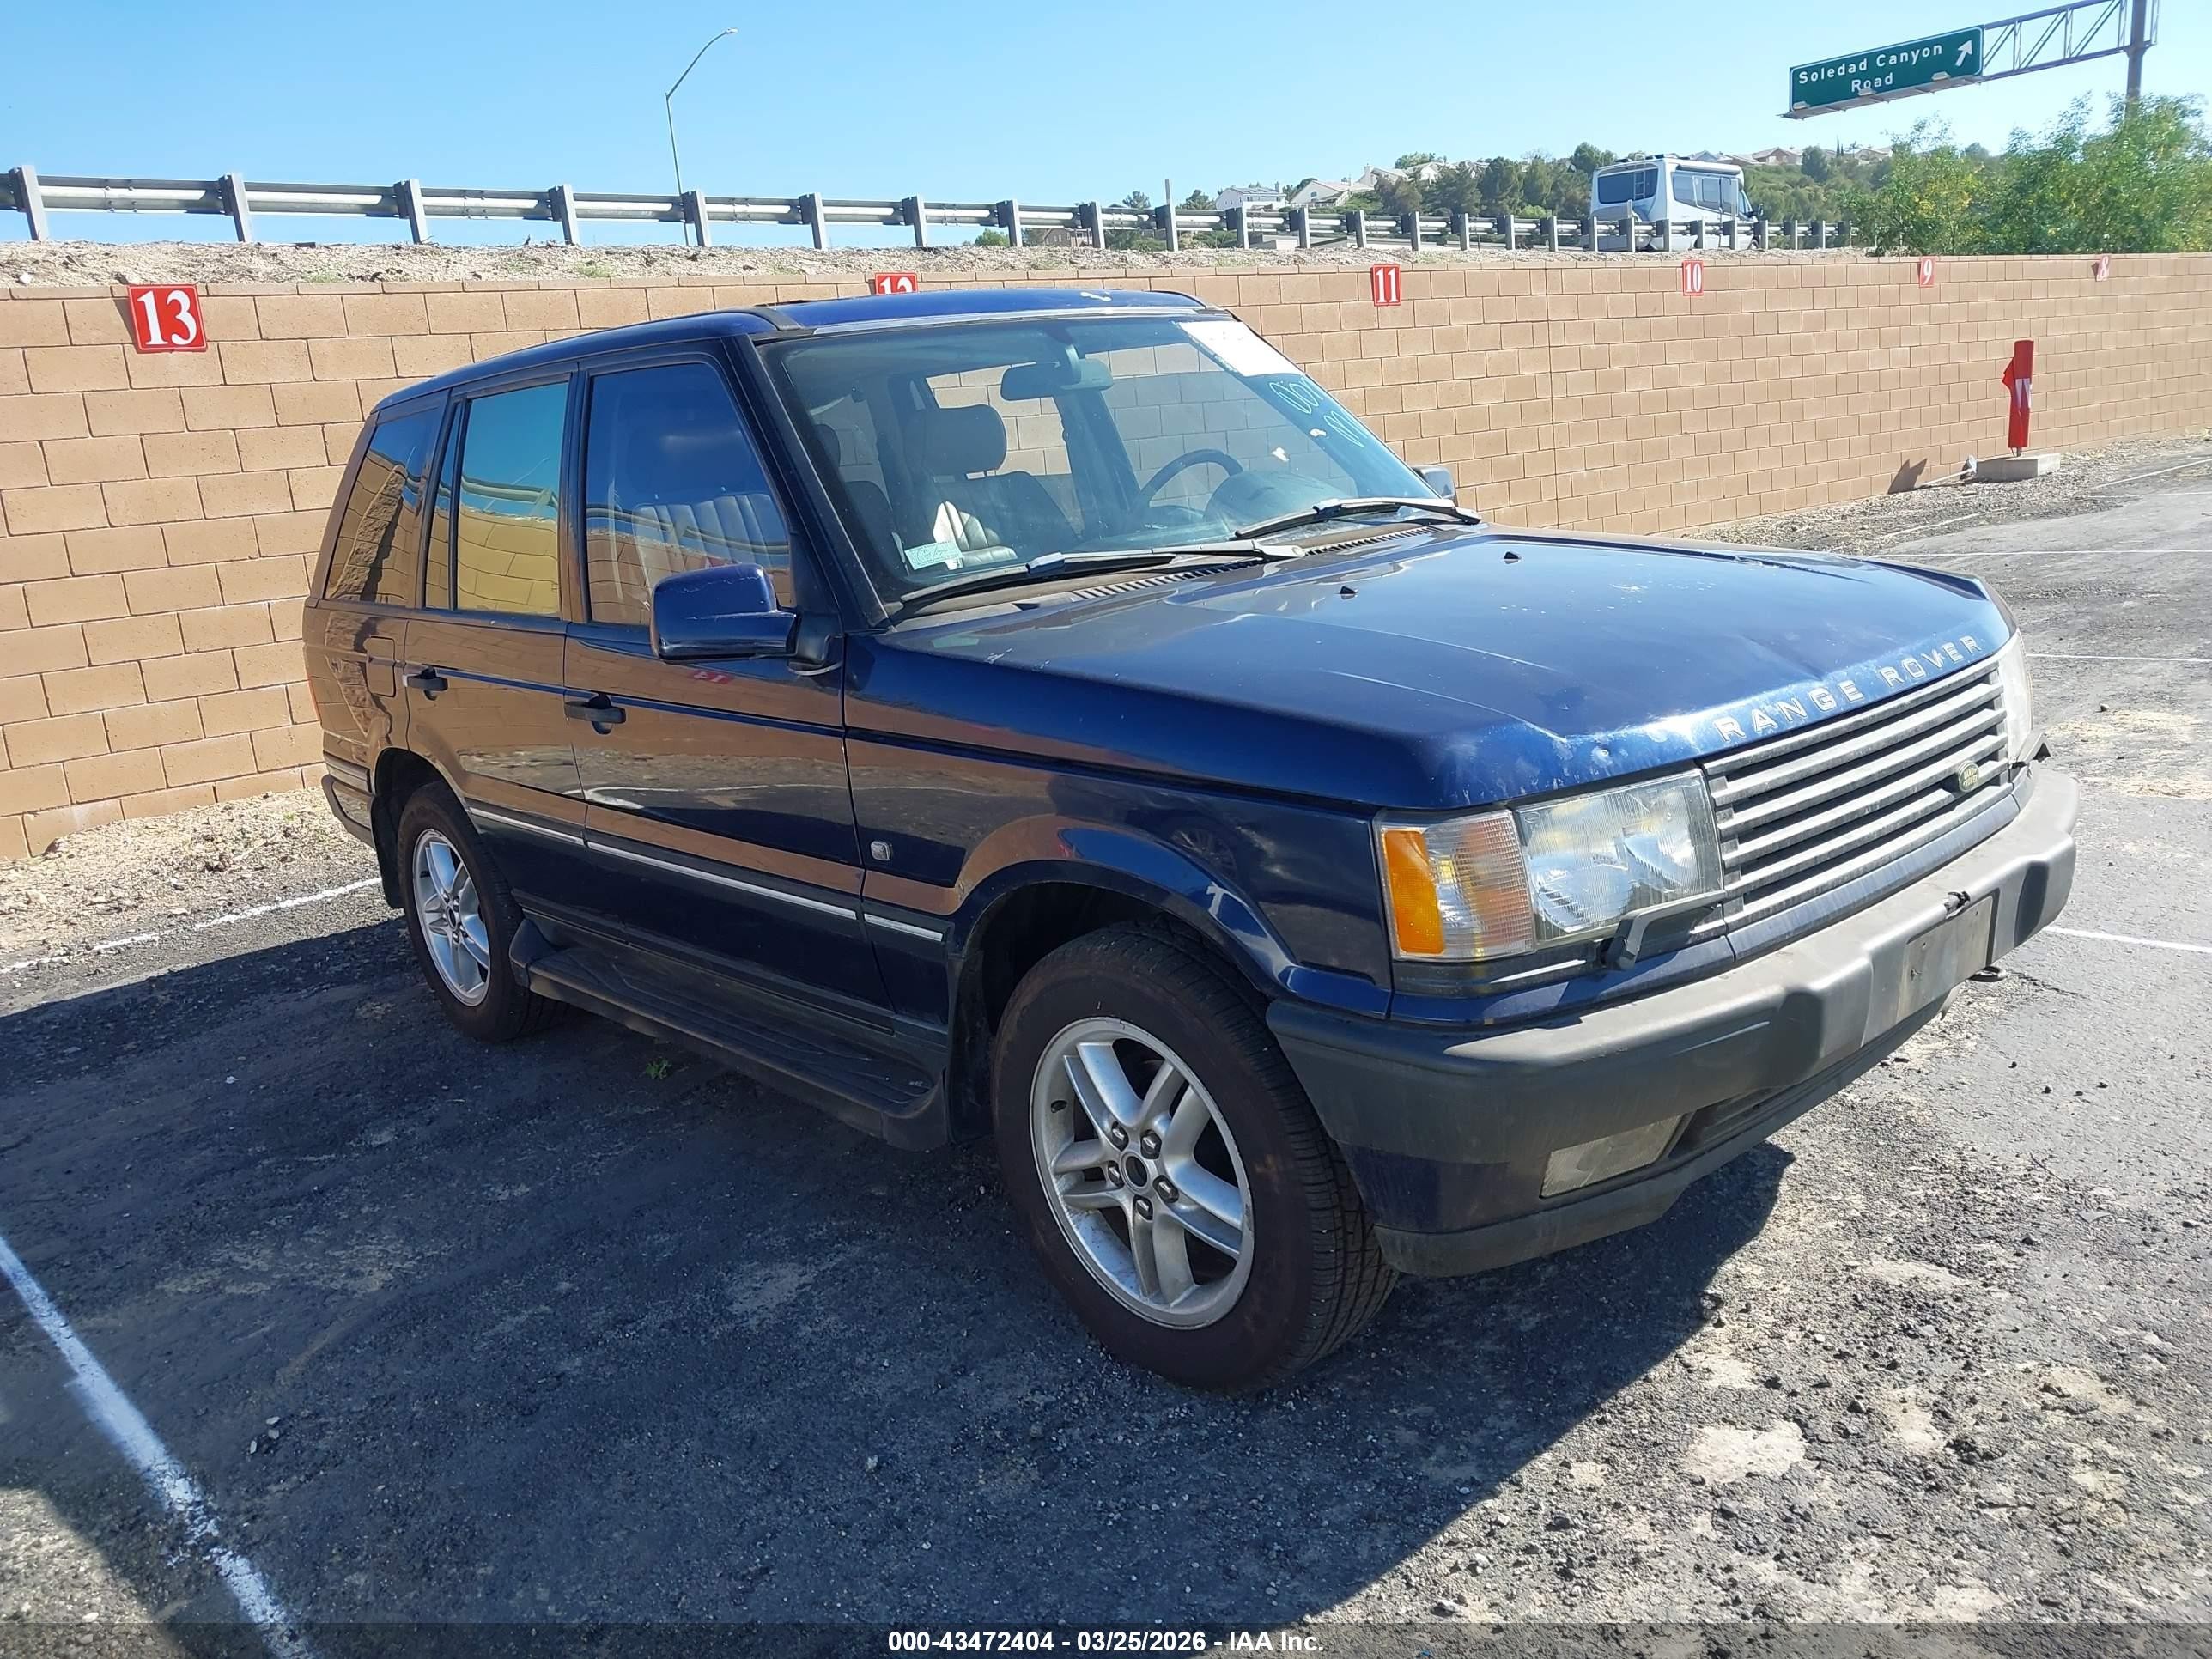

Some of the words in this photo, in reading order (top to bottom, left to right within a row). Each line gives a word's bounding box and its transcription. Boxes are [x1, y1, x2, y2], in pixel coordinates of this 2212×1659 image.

[1798, 58, 1868, 84] Soledad
[1875, 44, 1943, 65] Canyon
[1850, 72, 1894, 93] Road
[1376, 267, 1400, 303] 11
[1685, 263, 1702, 293] 10
[1923, 258, 1932, 285] 9
[137, 289, 198, 346] 13
[1712, 679, 1865, 742] RANGE
[1879, 635, 1983, 688] ROVER
